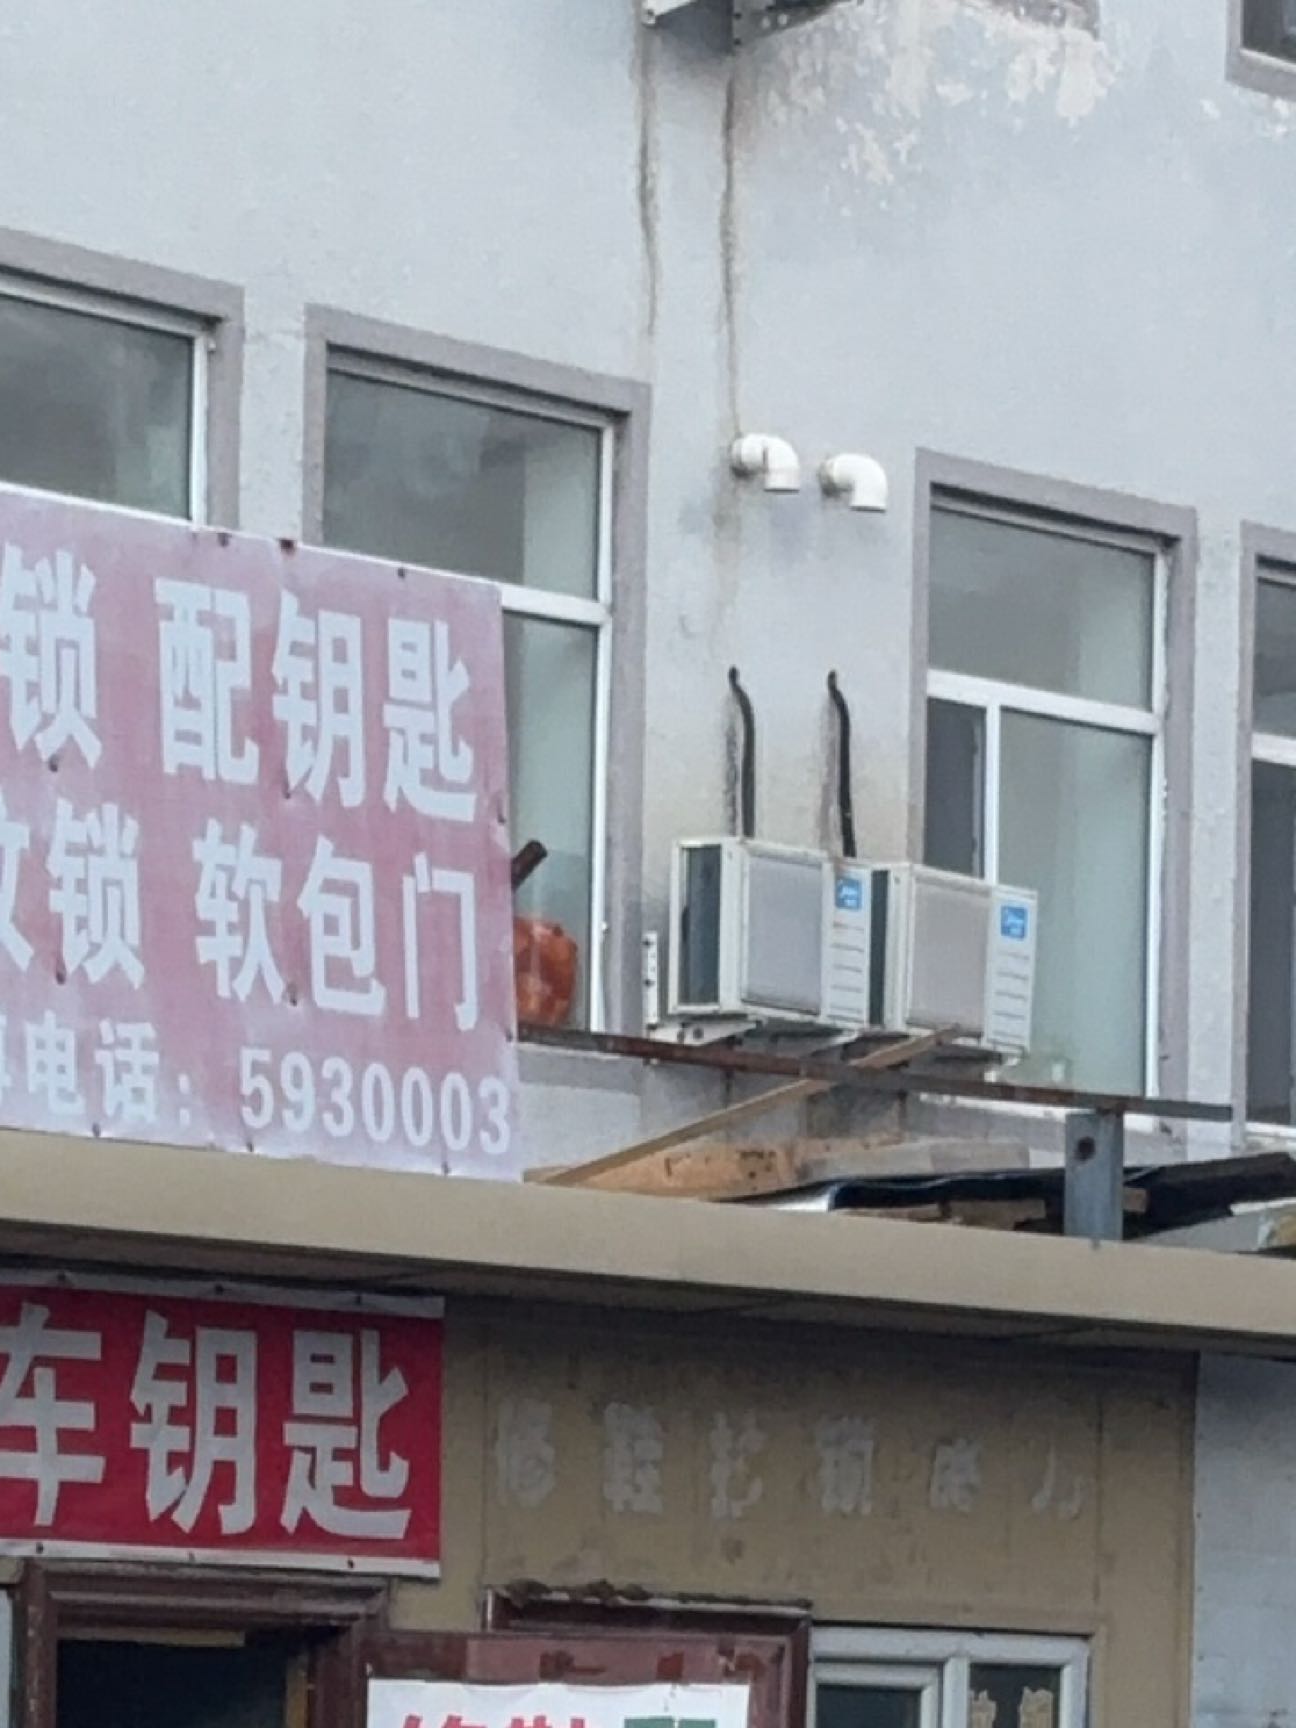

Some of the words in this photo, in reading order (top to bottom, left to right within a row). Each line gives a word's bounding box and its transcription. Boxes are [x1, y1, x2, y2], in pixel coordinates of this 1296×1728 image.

[154, 578, 478, 822] 配钥匙
[193, 818, 478, 1033] 软包门
